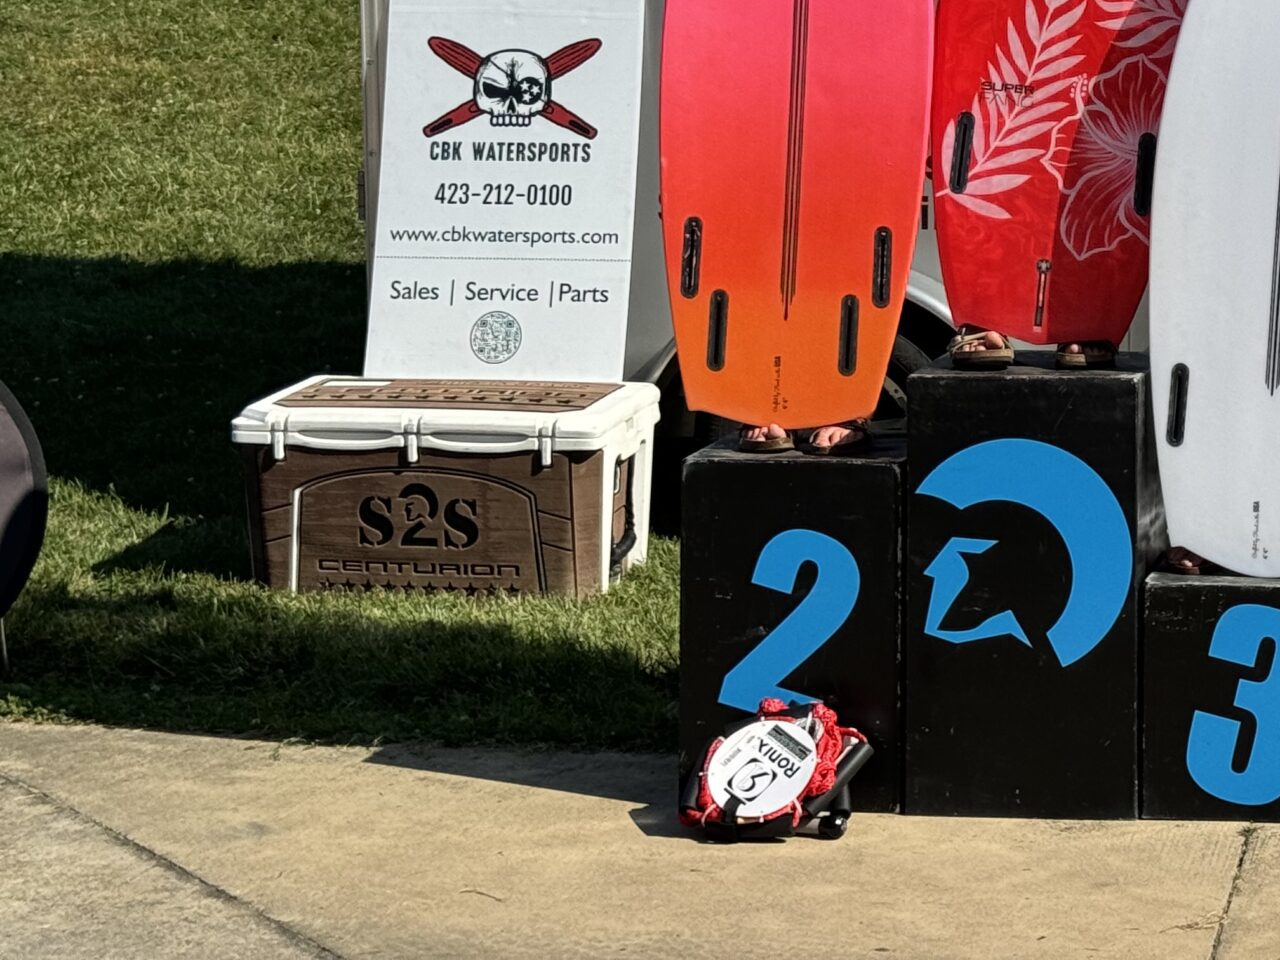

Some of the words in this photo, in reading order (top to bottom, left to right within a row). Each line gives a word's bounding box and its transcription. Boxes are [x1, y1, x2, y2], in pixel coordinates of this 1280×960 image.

[981, 81, 1035, 95] SUPER
[429, 141, 463, 161] CBK
[473, 142, 591, 162] WATERSPORTS
[434, 183, 572, 206] 423-212-0100
[390, 227, 619, 247] www.cbkwatersports.com
[390, 281, 439, 301] Sales
[465, 282, 539, 302] Service
[559, 284, 609, 303] Parts
[358, 483, 479, 551] S2S
[318, 559, 520, 578] CENTURION
[718, 528, 860, 715] 2
